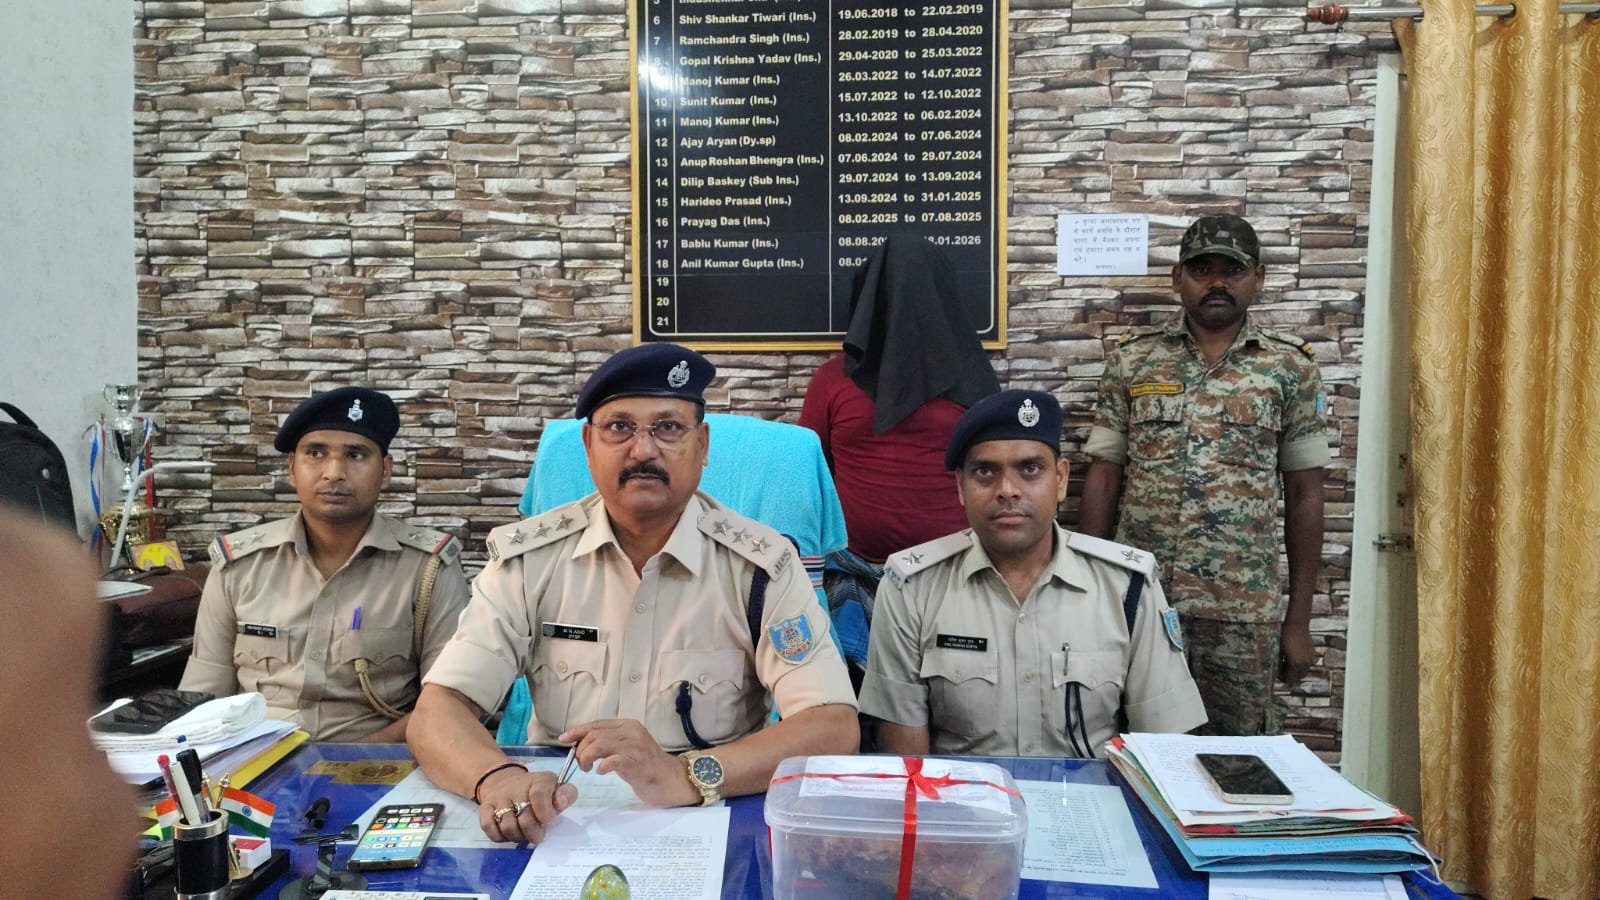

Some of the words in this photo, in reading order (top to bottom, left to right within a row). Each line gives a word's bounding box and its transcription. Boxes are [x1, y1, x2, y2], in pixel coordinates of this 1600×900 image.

[653, 15, 661, 25] 6
[679, 14, 703, 25] Shiv
[704, 13, 750, 24] Shankar
[751, 12, 786, 23] Tiwari
[788, 11, 817, 24] (Ins.)
[838, 7, 898, 20] 19.06.2018
[903, 7, 916, 17] to
[921, 3, 984, 16] 22.02.2019
[653, 36, 661, 47] 7
[679, 34, 747, 46] Ramchandra
[749, 33, 780, 46] Singh
[782, 32, 810, 45] (Ins.)
[838, 28, 899, 41] 28.02.2019
[904, 29, 917, 38] to
[921, 25, 983, 38] 28.04.2020
[679, 55, 711, 68] Gopal
[713, 54, 755, 65] Krishna
[757, 53, 791, 64] Yadav
[793, 52, 822, 65] (Ins.)
[904, 49, 917, 59] to
[921, 46, 983, 59] 25.03.2022
[680, 75, 712, 88] Manoj
[714, 75, 751, 86] Kumar
[752, 74, 781, 87] (Ins.)
[838, 70, 899, 82] 26.03.2022
[904, 70, 916, 80] to
[921, 66, 982, 79] 14.07.2022
[655, 97, 668, 107] 10
[679, 96, 708, 107] Sunit
[710, 96, 746, 106] Kumar
[749, 94, 777, 107] (Ins.)
[838, 90, 898, 102] 15.07.2022
[903, 91, 916, 101] to
[920, 87, 982, 100] 12.10.2022
[654, 117, 667, 128] 11
[679, 116, 713, 128] Manoj
[714, 115, 751, 126] Kumar
[751, 115, 780, 127] (Ins.)
[838, 111, 898, 123] 13.10.2022
[903, 111, 916, 121] to
[920, 108, 982, 121] 06.02.2024
[655, 137, 668, 147] 12
[680, 136, 704, 149] Ajay
[705, 136, 738, 148] Aryan
[738, 135, 776, 148] (Dy.sp)
[838, 131, 898, 143] 08.02.2024
[903, 132, 916, 141] to
[920, 129, 982, 141] 07.06.2024
[655, 157, 669, 168] 13
[680, 157, 708, 169] Anup
[708, 156, 748, 166] Roshan
[749, 155, 794, 167] Bhengra
[796, 154, 825, 166] (Ins.)
[837, 152, 898, 164] 07.06.2024
[903, 152, 916, 162] to
[921, 150, 982, 161] 29.07.2024
[655, 177, 669, 187] 14
[680, 176, 705, 189] Dilip
[707, 176, 746, 188] Baskey
[748, 175, 773, 187] (Sub
[775, 174, 800, 186] Ins.)
[838, 172, 899, 184] 29.07.2024
[904, 172, 917, 182] to
[921, 170, 982, 182] 13.09.2024
[655, 197, 669, 207] 15
[680, 196, 722, 207] Harideo
[724, 195, 762, 206] Prasad
[764, 195, 792, 207] (Ins.)
[838, 192, 898, 204] 13.09.2024
[903, 193, 915, 203] to
[921, 191, 982, 202] 31.01.2025
[655, 217, 669, 227] 16
[680, 216, 718, 229] Prayag
[720, 216, 741, 226] Das
[742, 215, 771, 228] (Ins.)
[838, 213, 899, 224] 08.02.2025
[904, 213, 916, 223] to
[921, 211, 982, 223] 07.08.2025
[655, 239, 669, 249] 17
[680, 239, 711, 249] Bablu
[713, 238, 749, 248] Kumar
[751, 238, 779, 250] (Ins.)
[656, 259, 669, 269] 18
[680, 258, 702, 269] Anil
[704, 258, 740, 268] Kumar
[741, 258, 774, 270] Gupta
[776, 257, 805, 270] (Ins.)
[656, 277, 670, 287] 19
[656, 297, 670, 306] 20
[656, 316, 669, 326] 21
